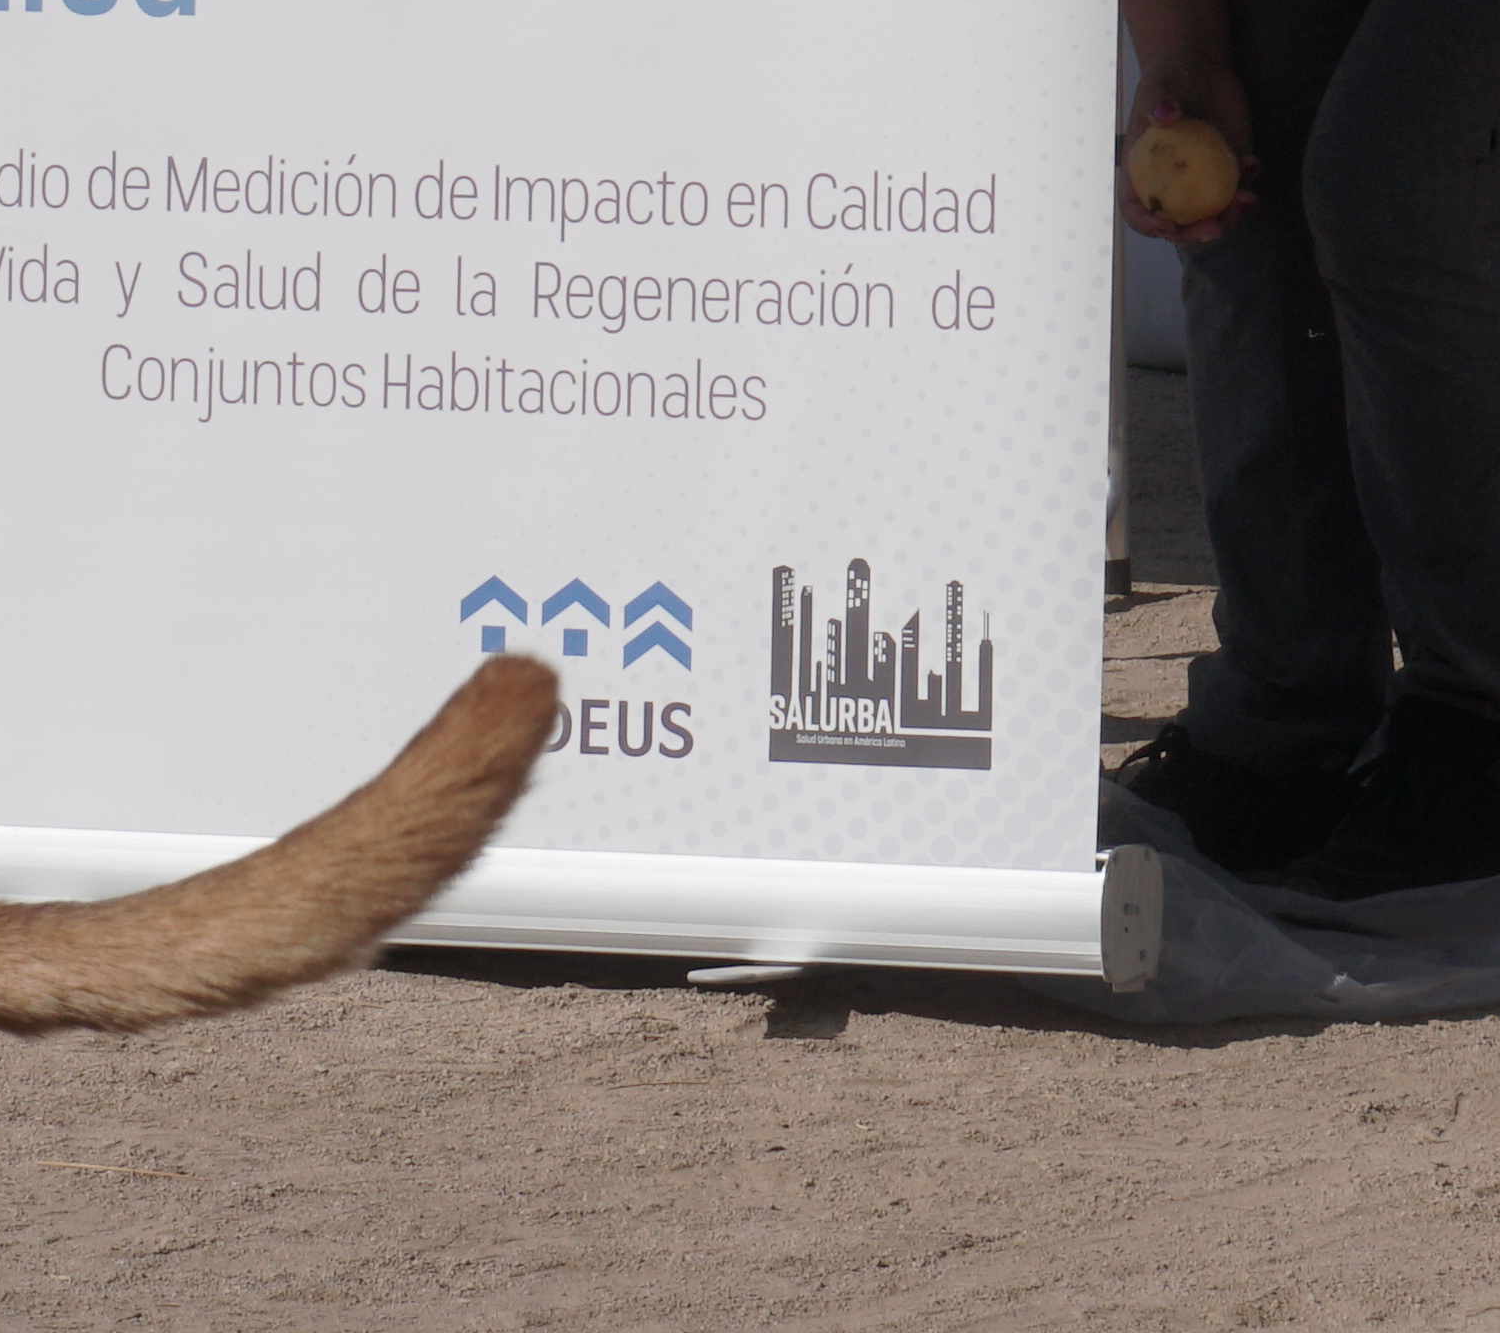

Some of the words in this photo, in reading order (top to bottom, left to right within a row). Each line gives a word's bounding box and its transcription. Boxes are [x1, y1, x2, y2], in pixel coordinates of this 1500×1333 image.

[88, 151, 150, 211] de
[167, 154, 396, 218] Medición
[415, 159, 478, 220] de
[494, 165, 708, 242] Impacto
[727, 183, 788, 228] en
[807, 171, 995, 234] Calidad
[115, 262, 141, 318] y
[178, 249, 321, 311] Salud
[358, 253, 420, 314] de
[457, 256, 496, 316] la
[534, 262, 893, 334] Regeneración
[932, 269, 995, 331] de
[102, 344, 366, 423] Conjuntos
[383, 351, 766, 421] Habitacionales
[795, 733, 816, 745] Salud
[817, 734, 843, 746] Urbana
[844, 737, 852, 746] en
[853, 734, 882, 747] América
[883, 736, 906, 748] Latina
